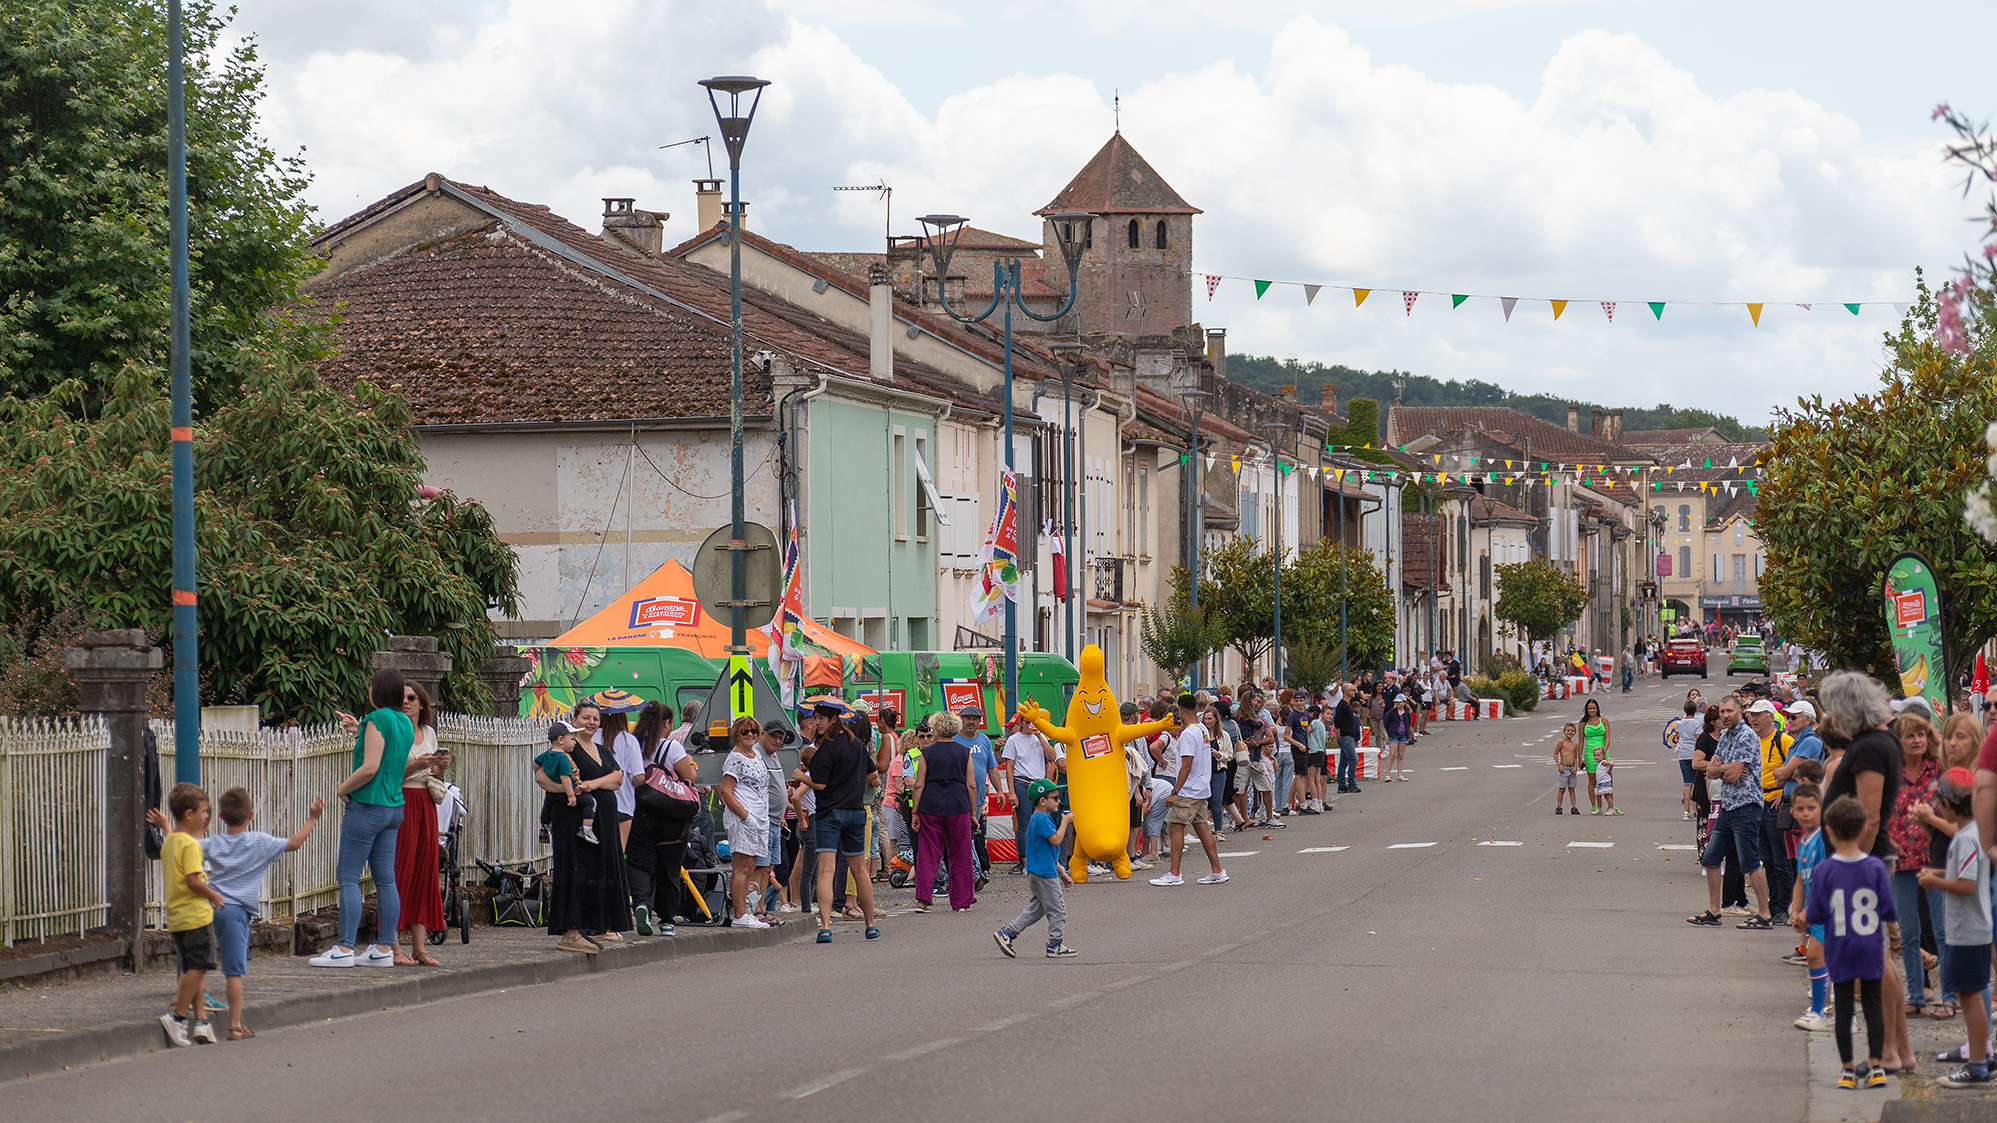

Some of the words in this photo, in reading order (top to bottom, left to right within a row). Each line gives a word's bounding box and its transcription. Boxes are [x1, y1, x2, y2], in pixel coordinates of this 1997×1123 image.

[645, 605, 688, 613] Banane
[951, 693, 977, 704] Banane
[658, 774, 685, 795] PUMA
[1829, 888, 1879, 936] 18
